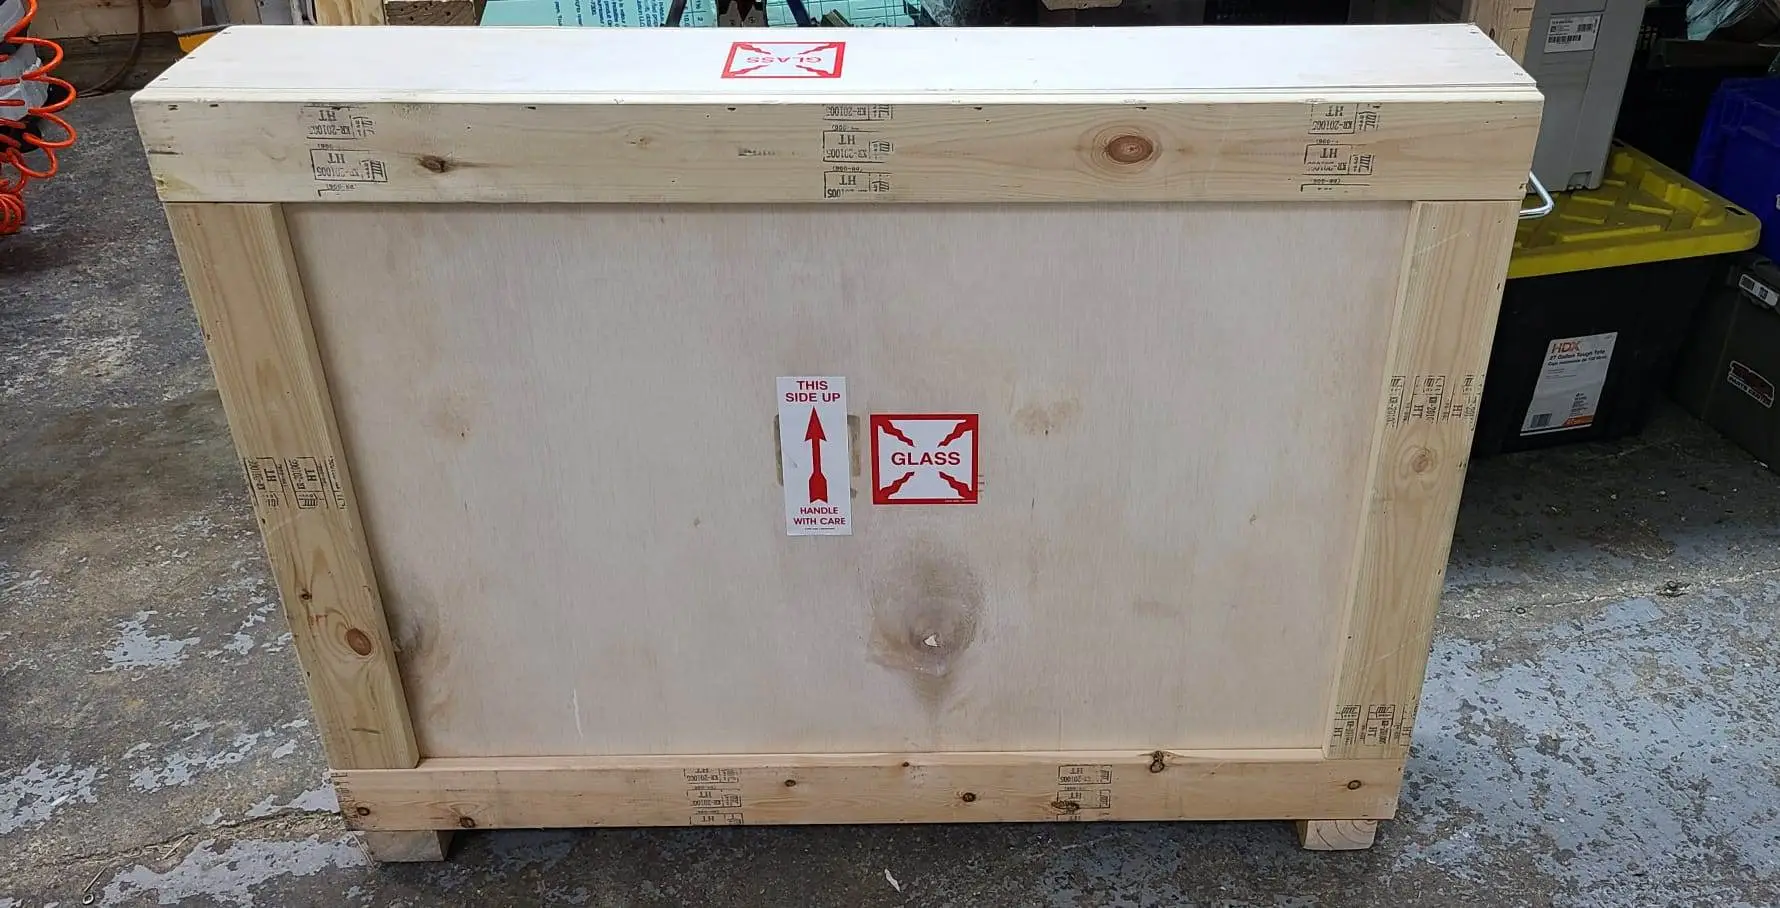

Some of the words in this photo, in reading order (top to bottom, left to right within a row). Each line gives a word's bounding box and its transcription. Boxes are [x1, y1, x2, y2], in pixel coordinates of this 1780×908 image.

[319, 110, 337, 121] HT
[1325, 106, 1344, 117] HT
[838, 134, 856, 145] HT
[1319, 147, 1338, 158] HT
[327, 153, 346, 164] HT
[839, 174, 857, 186] HT
[1552, 341, 1580, 353] HDX
[796, 380, 828, 391] THIS
[785, 392, 817, 403] SIDE
[822, 392, 841, 403] UP
[1412, 404, 1424, 420] HT
[1452, 404, 1464, 419] HT
[891, 451, 961, 466] GLASS
[264, 467, 278, 482] HT
[304, 467, 318, 483] HT
[799, 506, 839, 515] HANDLE
[793, 517, 816, 526] WITH
[819, 517, 846, 526] CARE
[1333, 727, 1344, 738] HT
